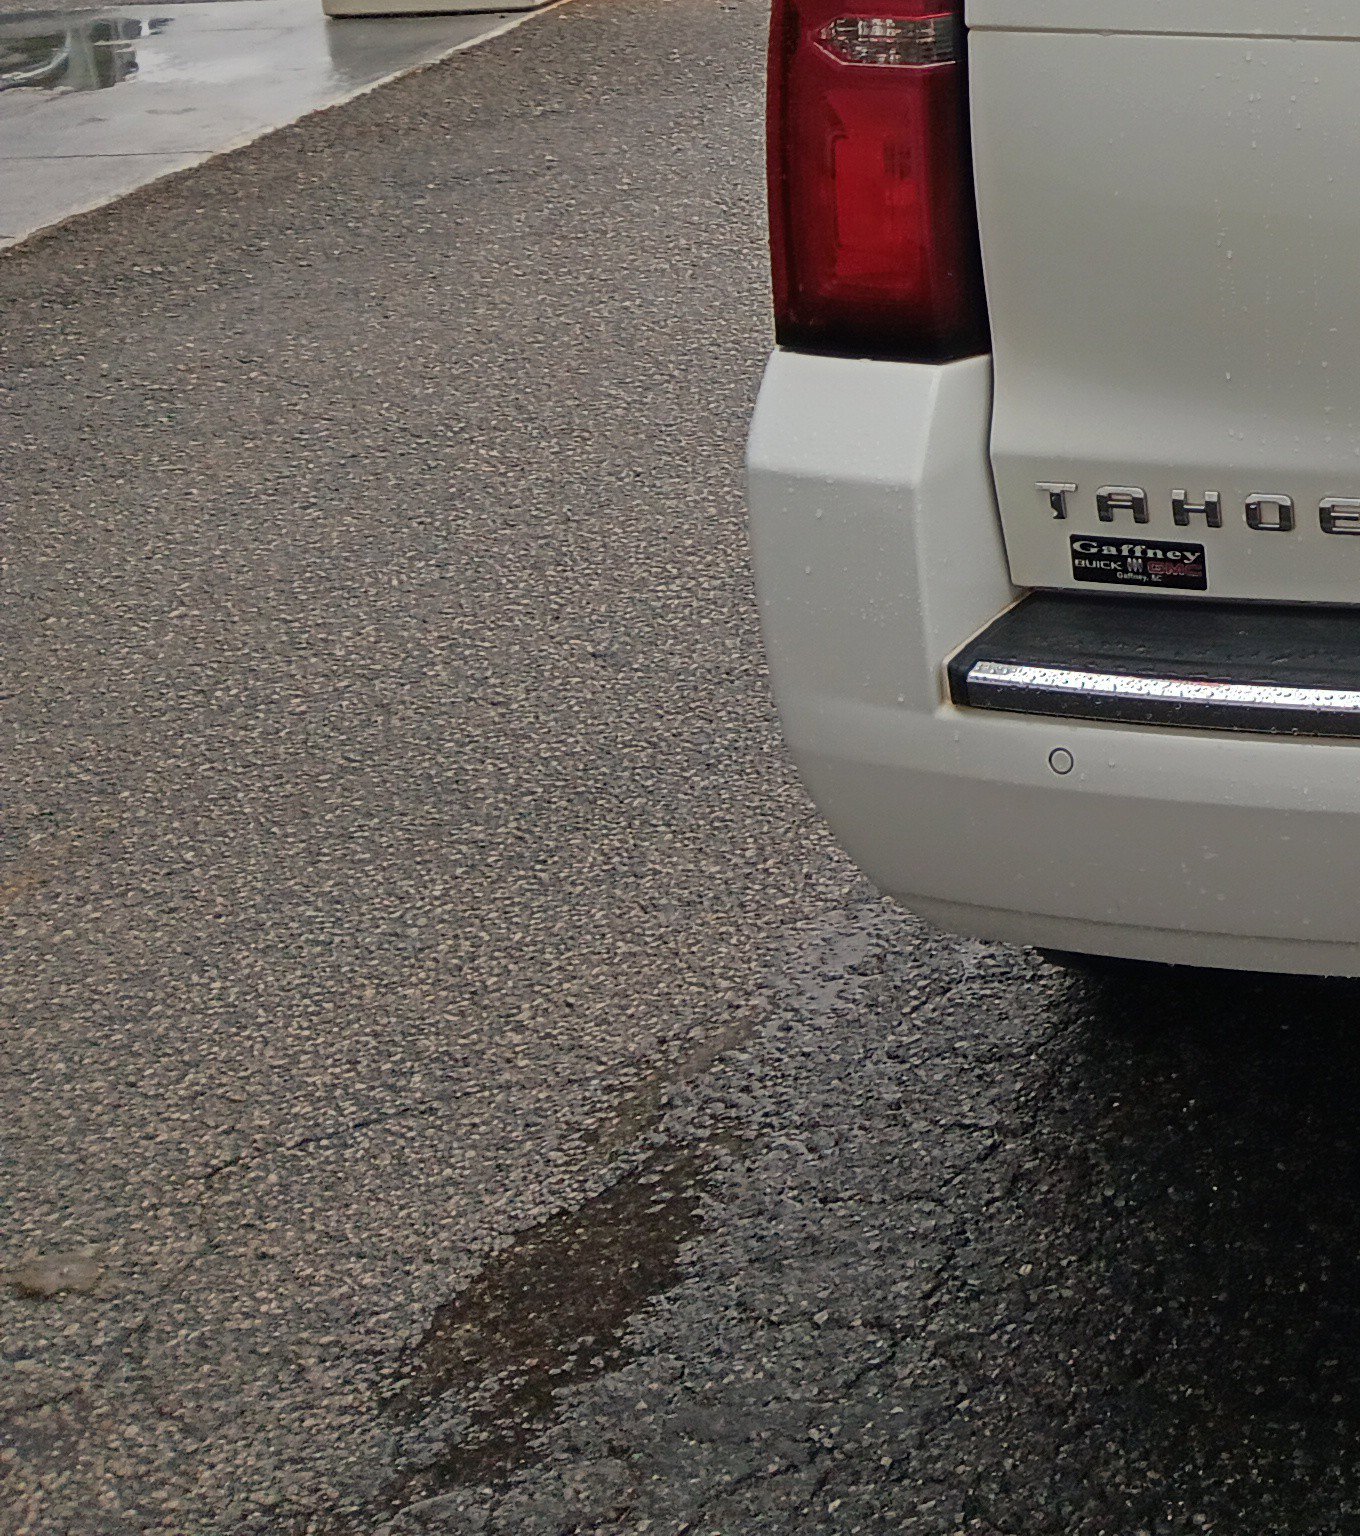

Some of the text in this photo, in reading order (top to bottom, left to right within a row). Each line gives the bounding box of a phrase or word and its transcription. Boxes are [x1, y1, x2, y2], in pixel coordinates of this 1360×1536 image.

[1072, 540, 1201, 564] Gaffney
[1074, 559, 1203, 577] BUICK GMC
